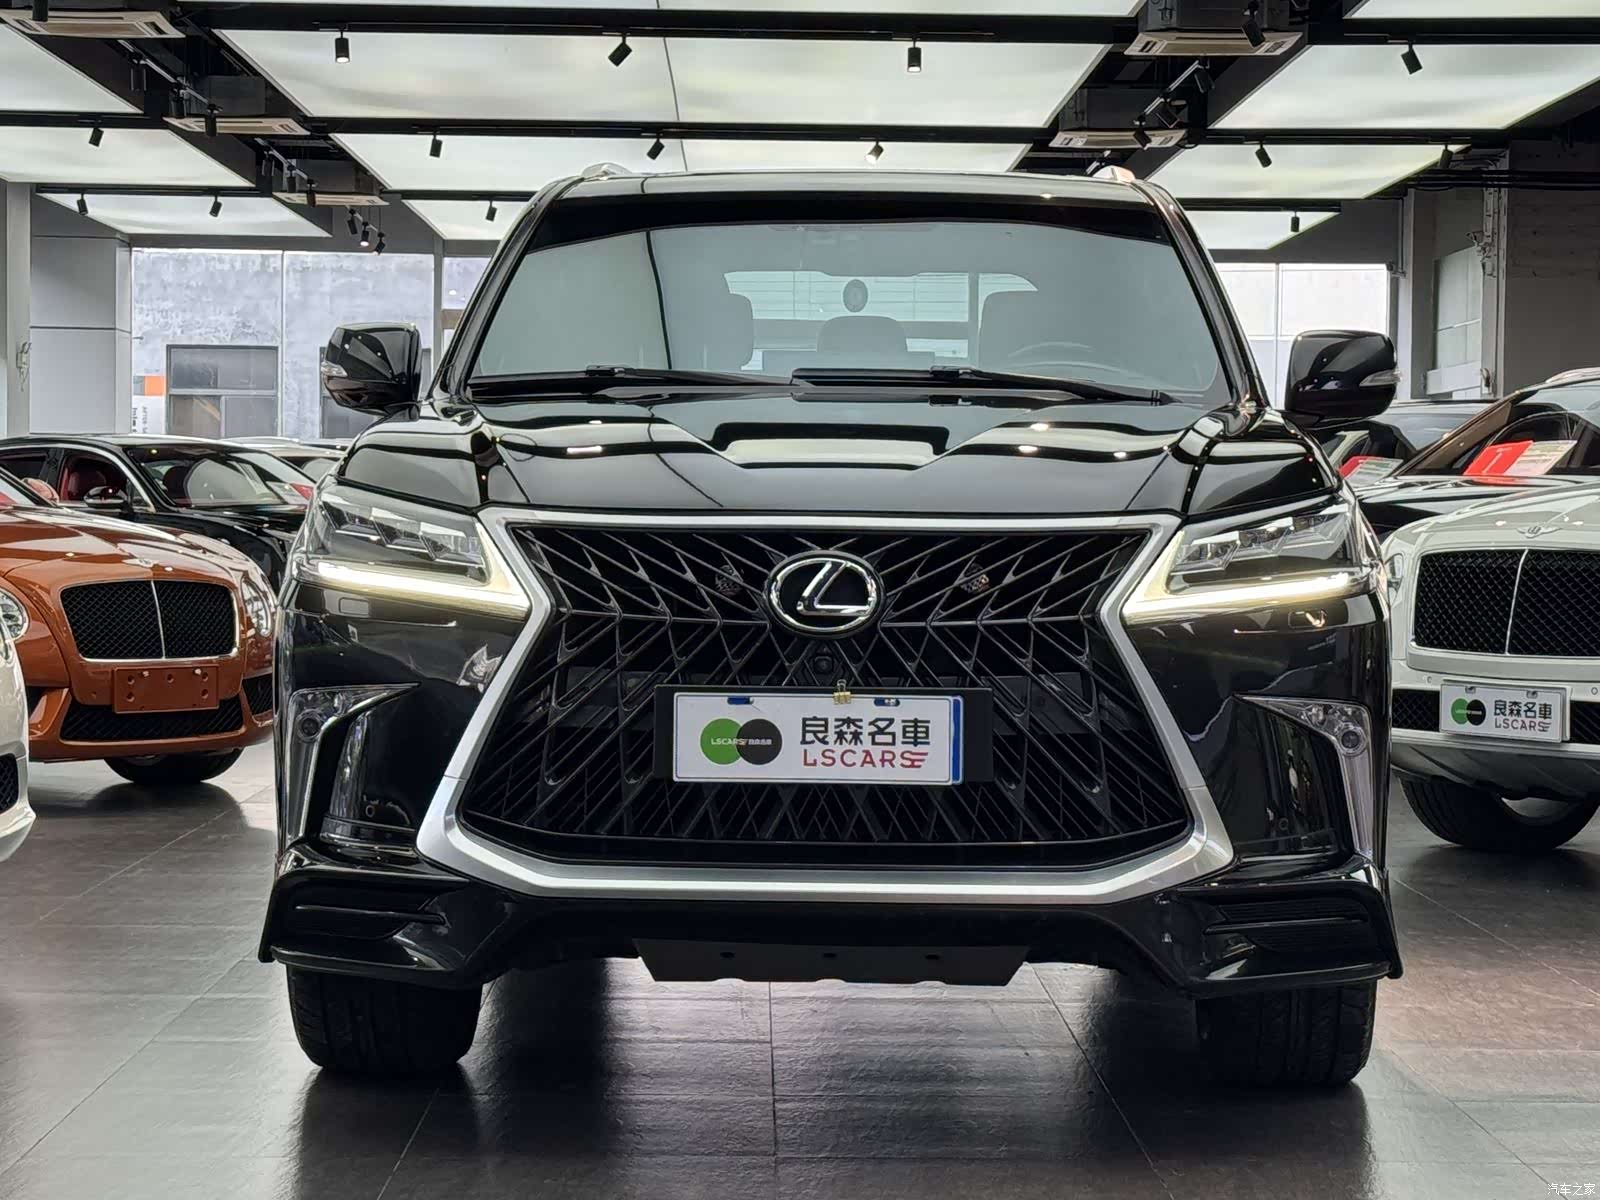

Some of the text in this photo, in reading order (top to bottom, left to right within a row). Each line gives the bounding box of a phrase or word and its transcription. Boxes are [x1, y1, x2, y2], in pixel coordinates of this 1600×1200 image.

[1493, 699, 1553, 720] 良森名車
[800, 716, 931, 746] 良森名車
[1494, 717, 1551, 732] LSCARS
[803, 749, 929, 769] LSCARS
